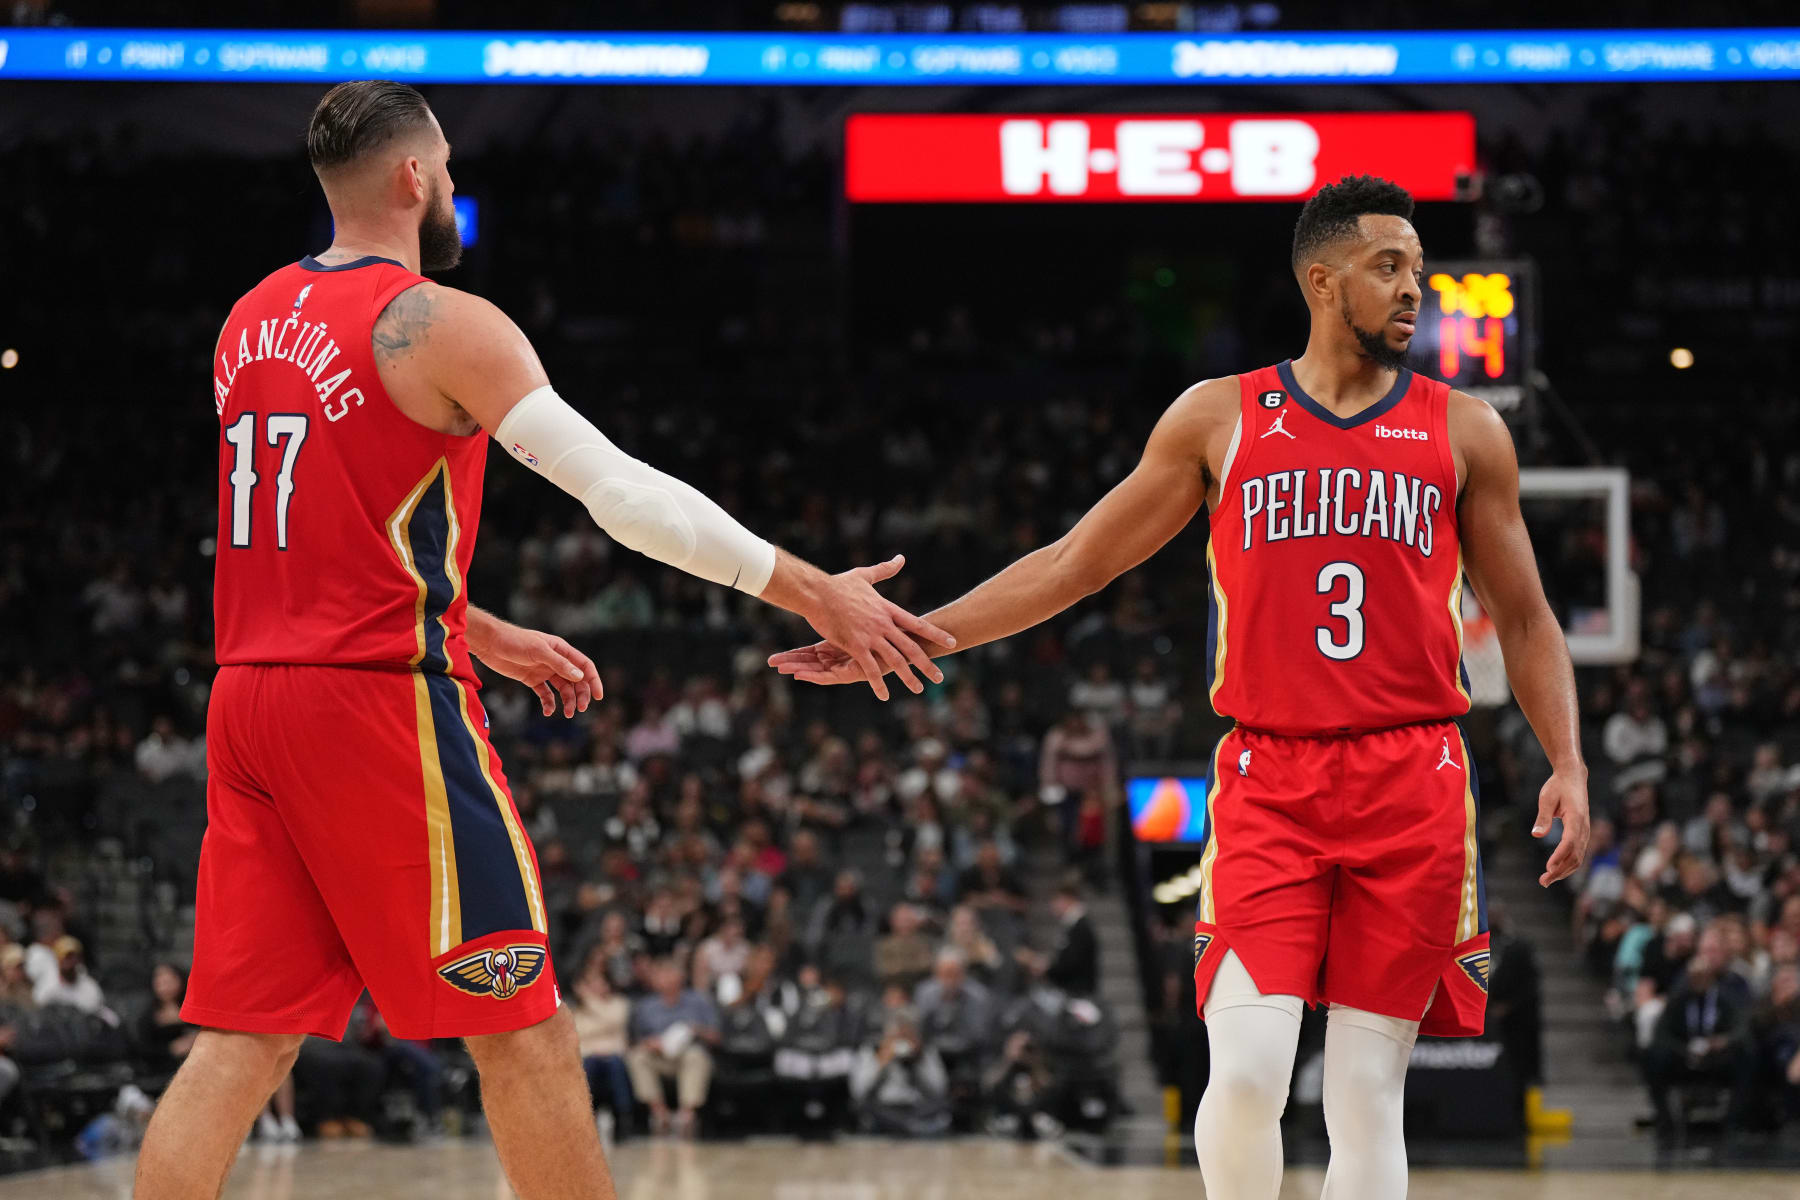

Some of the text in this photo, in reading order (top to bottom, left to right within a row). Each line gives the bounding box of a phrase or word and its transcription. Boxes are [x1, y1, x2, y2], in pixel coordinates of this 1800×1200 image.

[1440, 316, 1504, 379] 14
[1265, 392, 1281, 408] 6
[1375, 425, 1429, 441] ibotta
[225, 411, 309, 551] 17
[1241, 467, 1441, 558] PELICANS
[1315, 560, 1366, 662] 3
